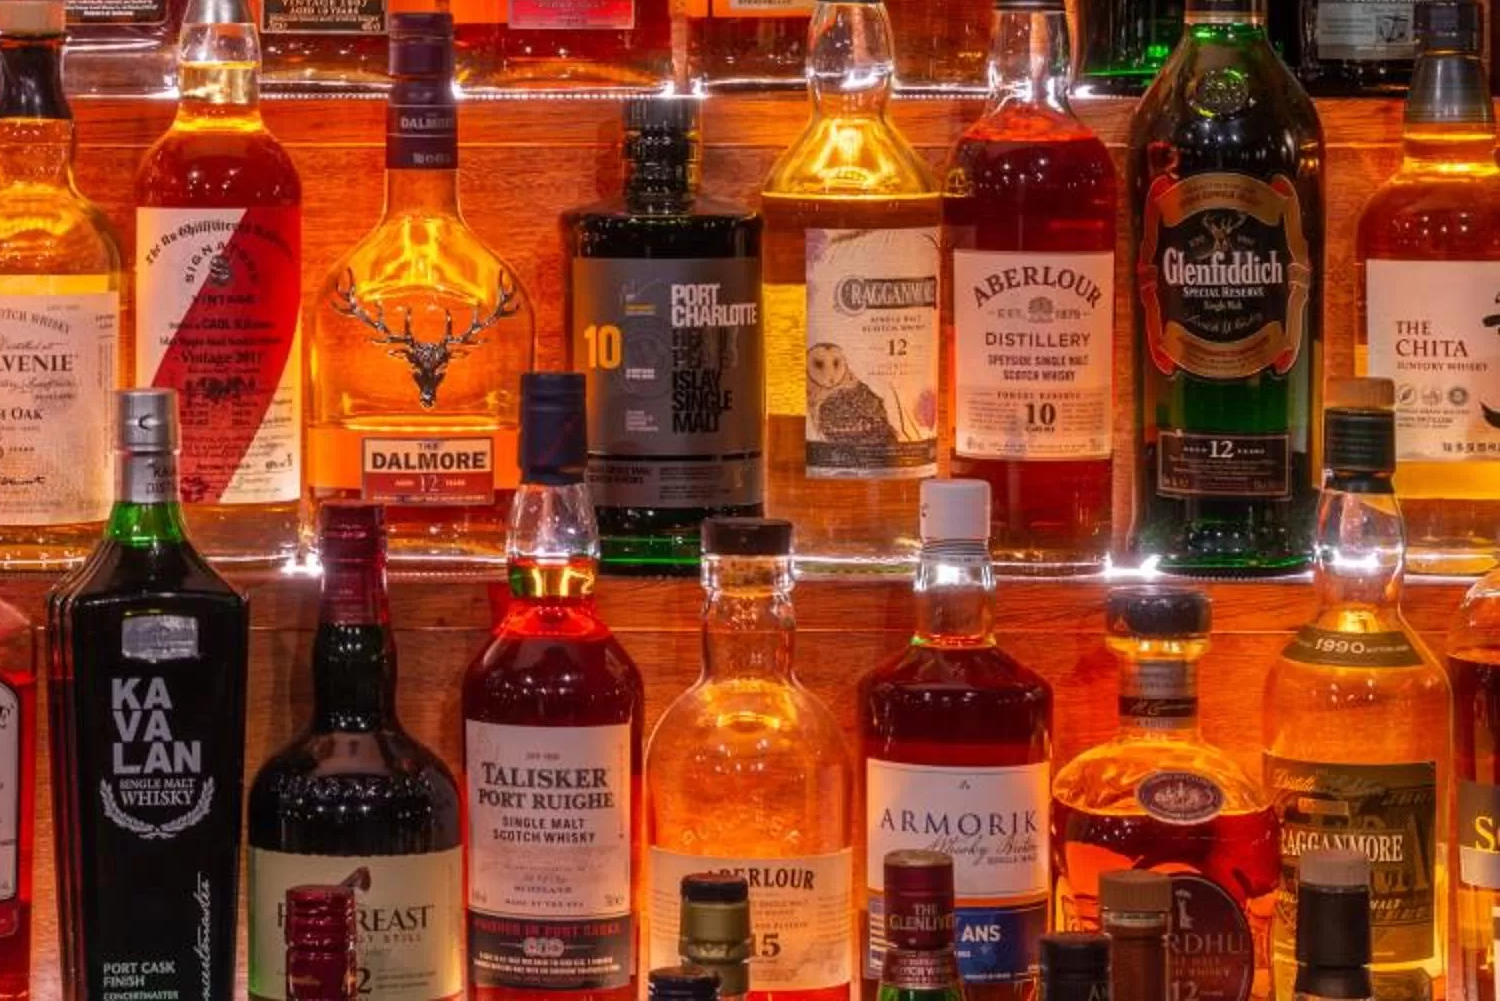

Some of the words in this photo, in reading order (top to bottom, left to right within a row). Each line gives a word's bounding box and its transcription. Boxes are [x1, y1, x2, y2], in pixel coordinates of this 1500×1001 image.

[1163, 247, 1283, 286] Glenfiddich
[671, 283, 720, 305] PORT
[971, 265, 1103, 308] ABERLOUR
[671, 303, 757, 327] CHARLOTTE
[1395, 320, 1431, 335] THE
[583, 324, 621, 368] 10
[887, 339, 908, 355] 12
[986, 331, 1091, 348] DISTILLERY
[1395, 339, 1468, 357] CHITA
[671, 370, 721, 390] ISLAY
[671, 390, 733, 411] SINGLE
[1024, 402, 1057, 425] 10
[1209, 440, 1235, 458] 12
[371, 452, 486, 471] DALMORE
[1316, 637, 1365, 655] 1990
[111, 678, 172, 710] KA
[112, 710, 171, 742] VA
[113, 742, 201, 775] LAN
[119, 778, 160, 789] SINGLE
[163, 778, 195, 788] MALT
[481, 761, 608, 788] TALISKER
[120, 791, 195, 806] WHISKY
[478, 789, 527, 808] PORT
[532, 790, 614, 809] RUIGHE
[503, 817, 547, 828] SINGLE
[551, 819, 586, 828] MALT
[880, 807, 1038, 836] ARMORIK
[493, 829, 542, 842] SCOTCH
[546, 831, 596, 843] WHISKY
[962, 925, 1001, 942] ANS
[103, 962, 137, 974] PORT
[141, 961, 175, 973] CASK
[104, 974, 145, 987] FINISH
